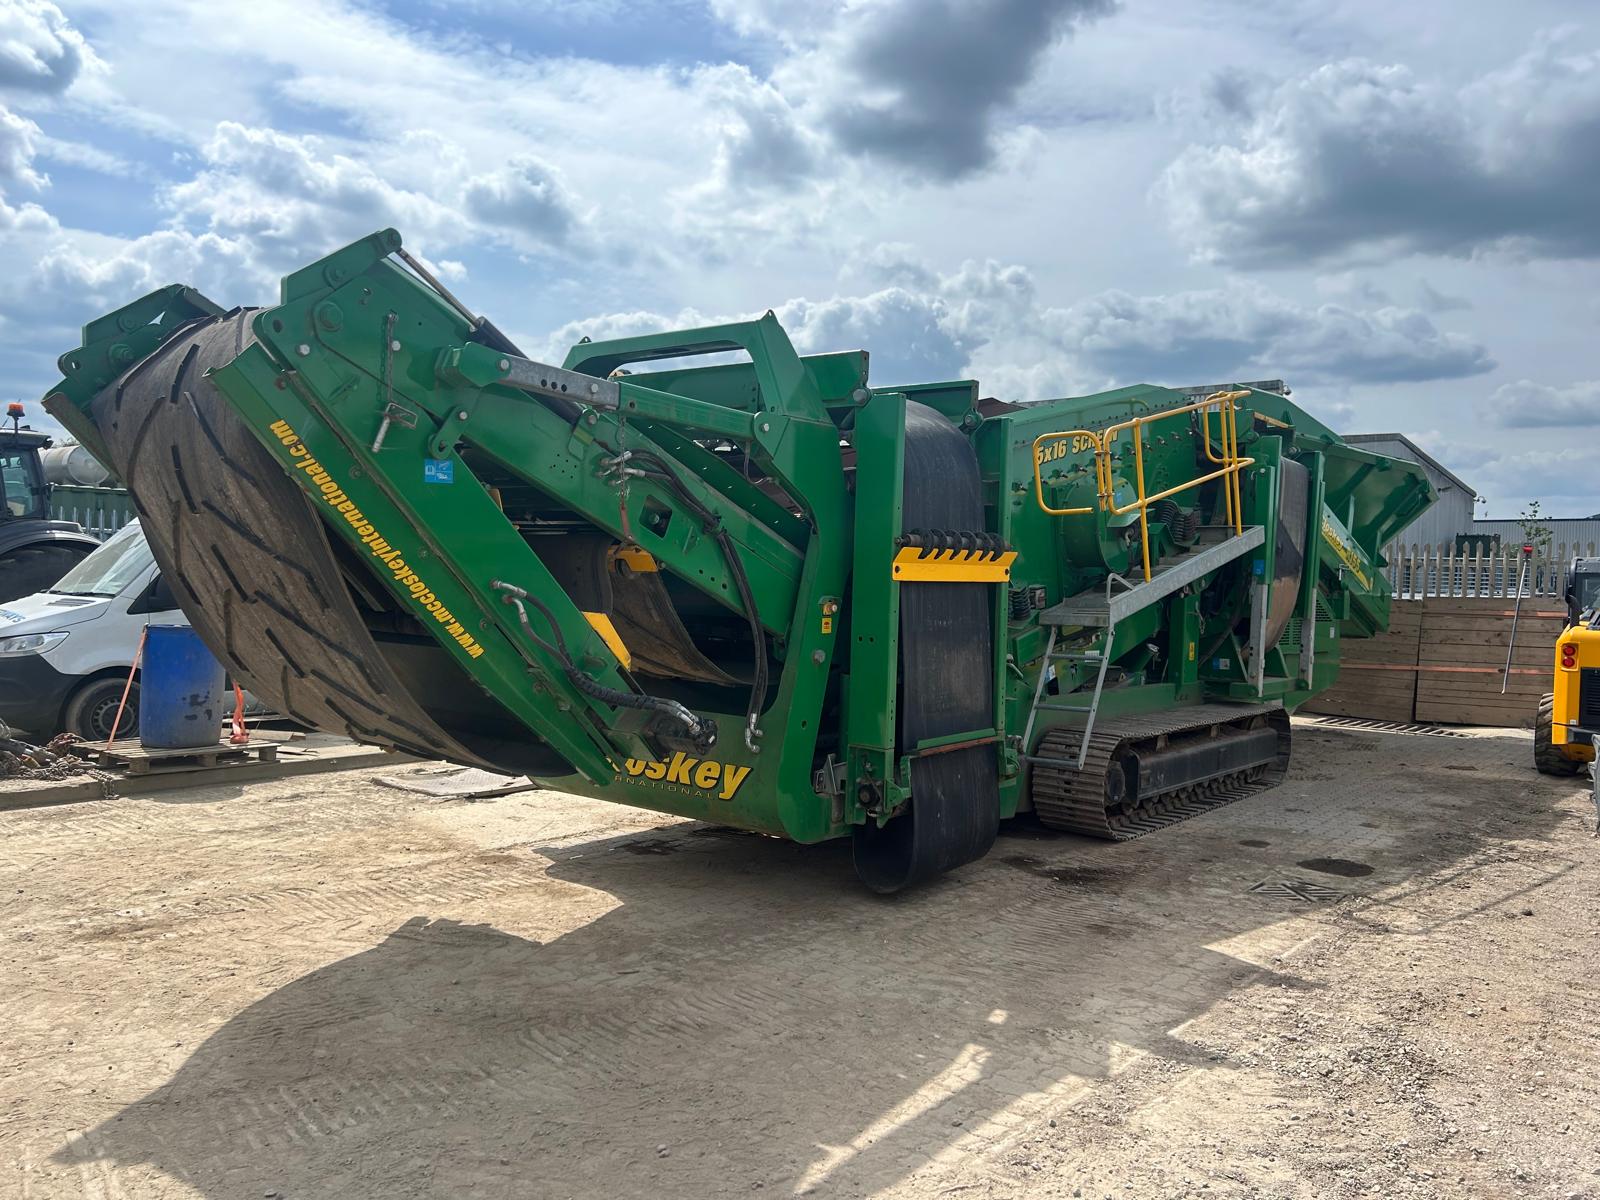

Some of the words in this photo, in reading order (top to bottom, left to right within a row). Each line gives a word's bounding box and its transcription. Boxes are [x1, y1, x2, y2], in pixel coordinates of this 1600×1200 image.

[1071, 429, 1118, 454] SCREN
[269, 419, 486, 659] www.mccloskeyinternational.com
[606, 751, 752, 800] oskey
[614, 774, 712, 799] RNATIONAL
